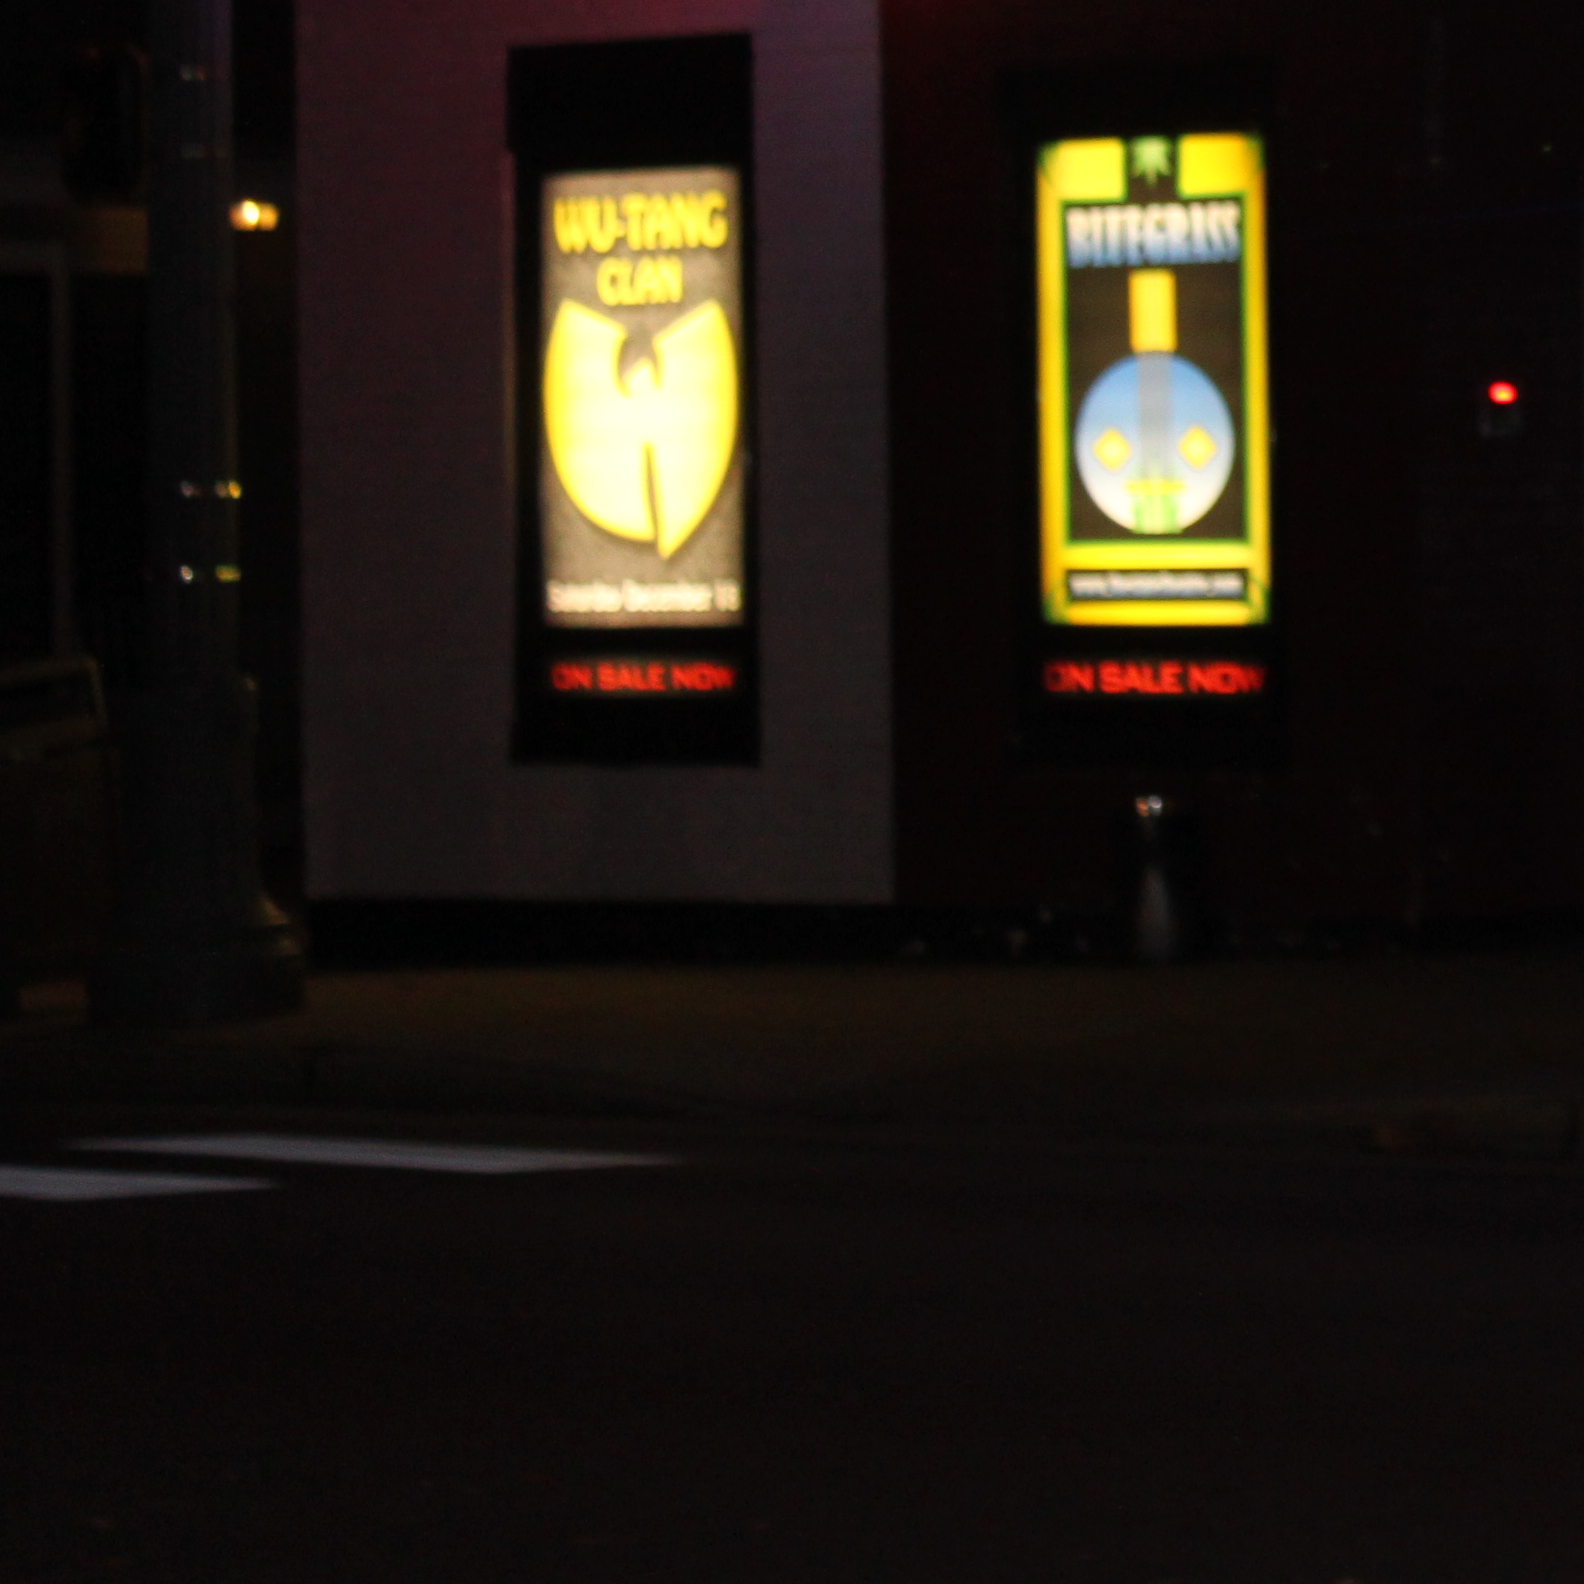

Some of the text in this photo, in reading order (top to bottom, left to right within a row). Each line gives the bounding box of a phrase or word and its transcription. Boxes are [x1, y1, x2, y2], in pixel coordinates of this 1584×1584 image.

[553, 189, 729, 254] WU-TANG
[596, 256, 684, 307] CLAN
[552, 661, 737, 692] ON SALE NOW
[1045, 660, 1266, 695] ON SALE NOW
